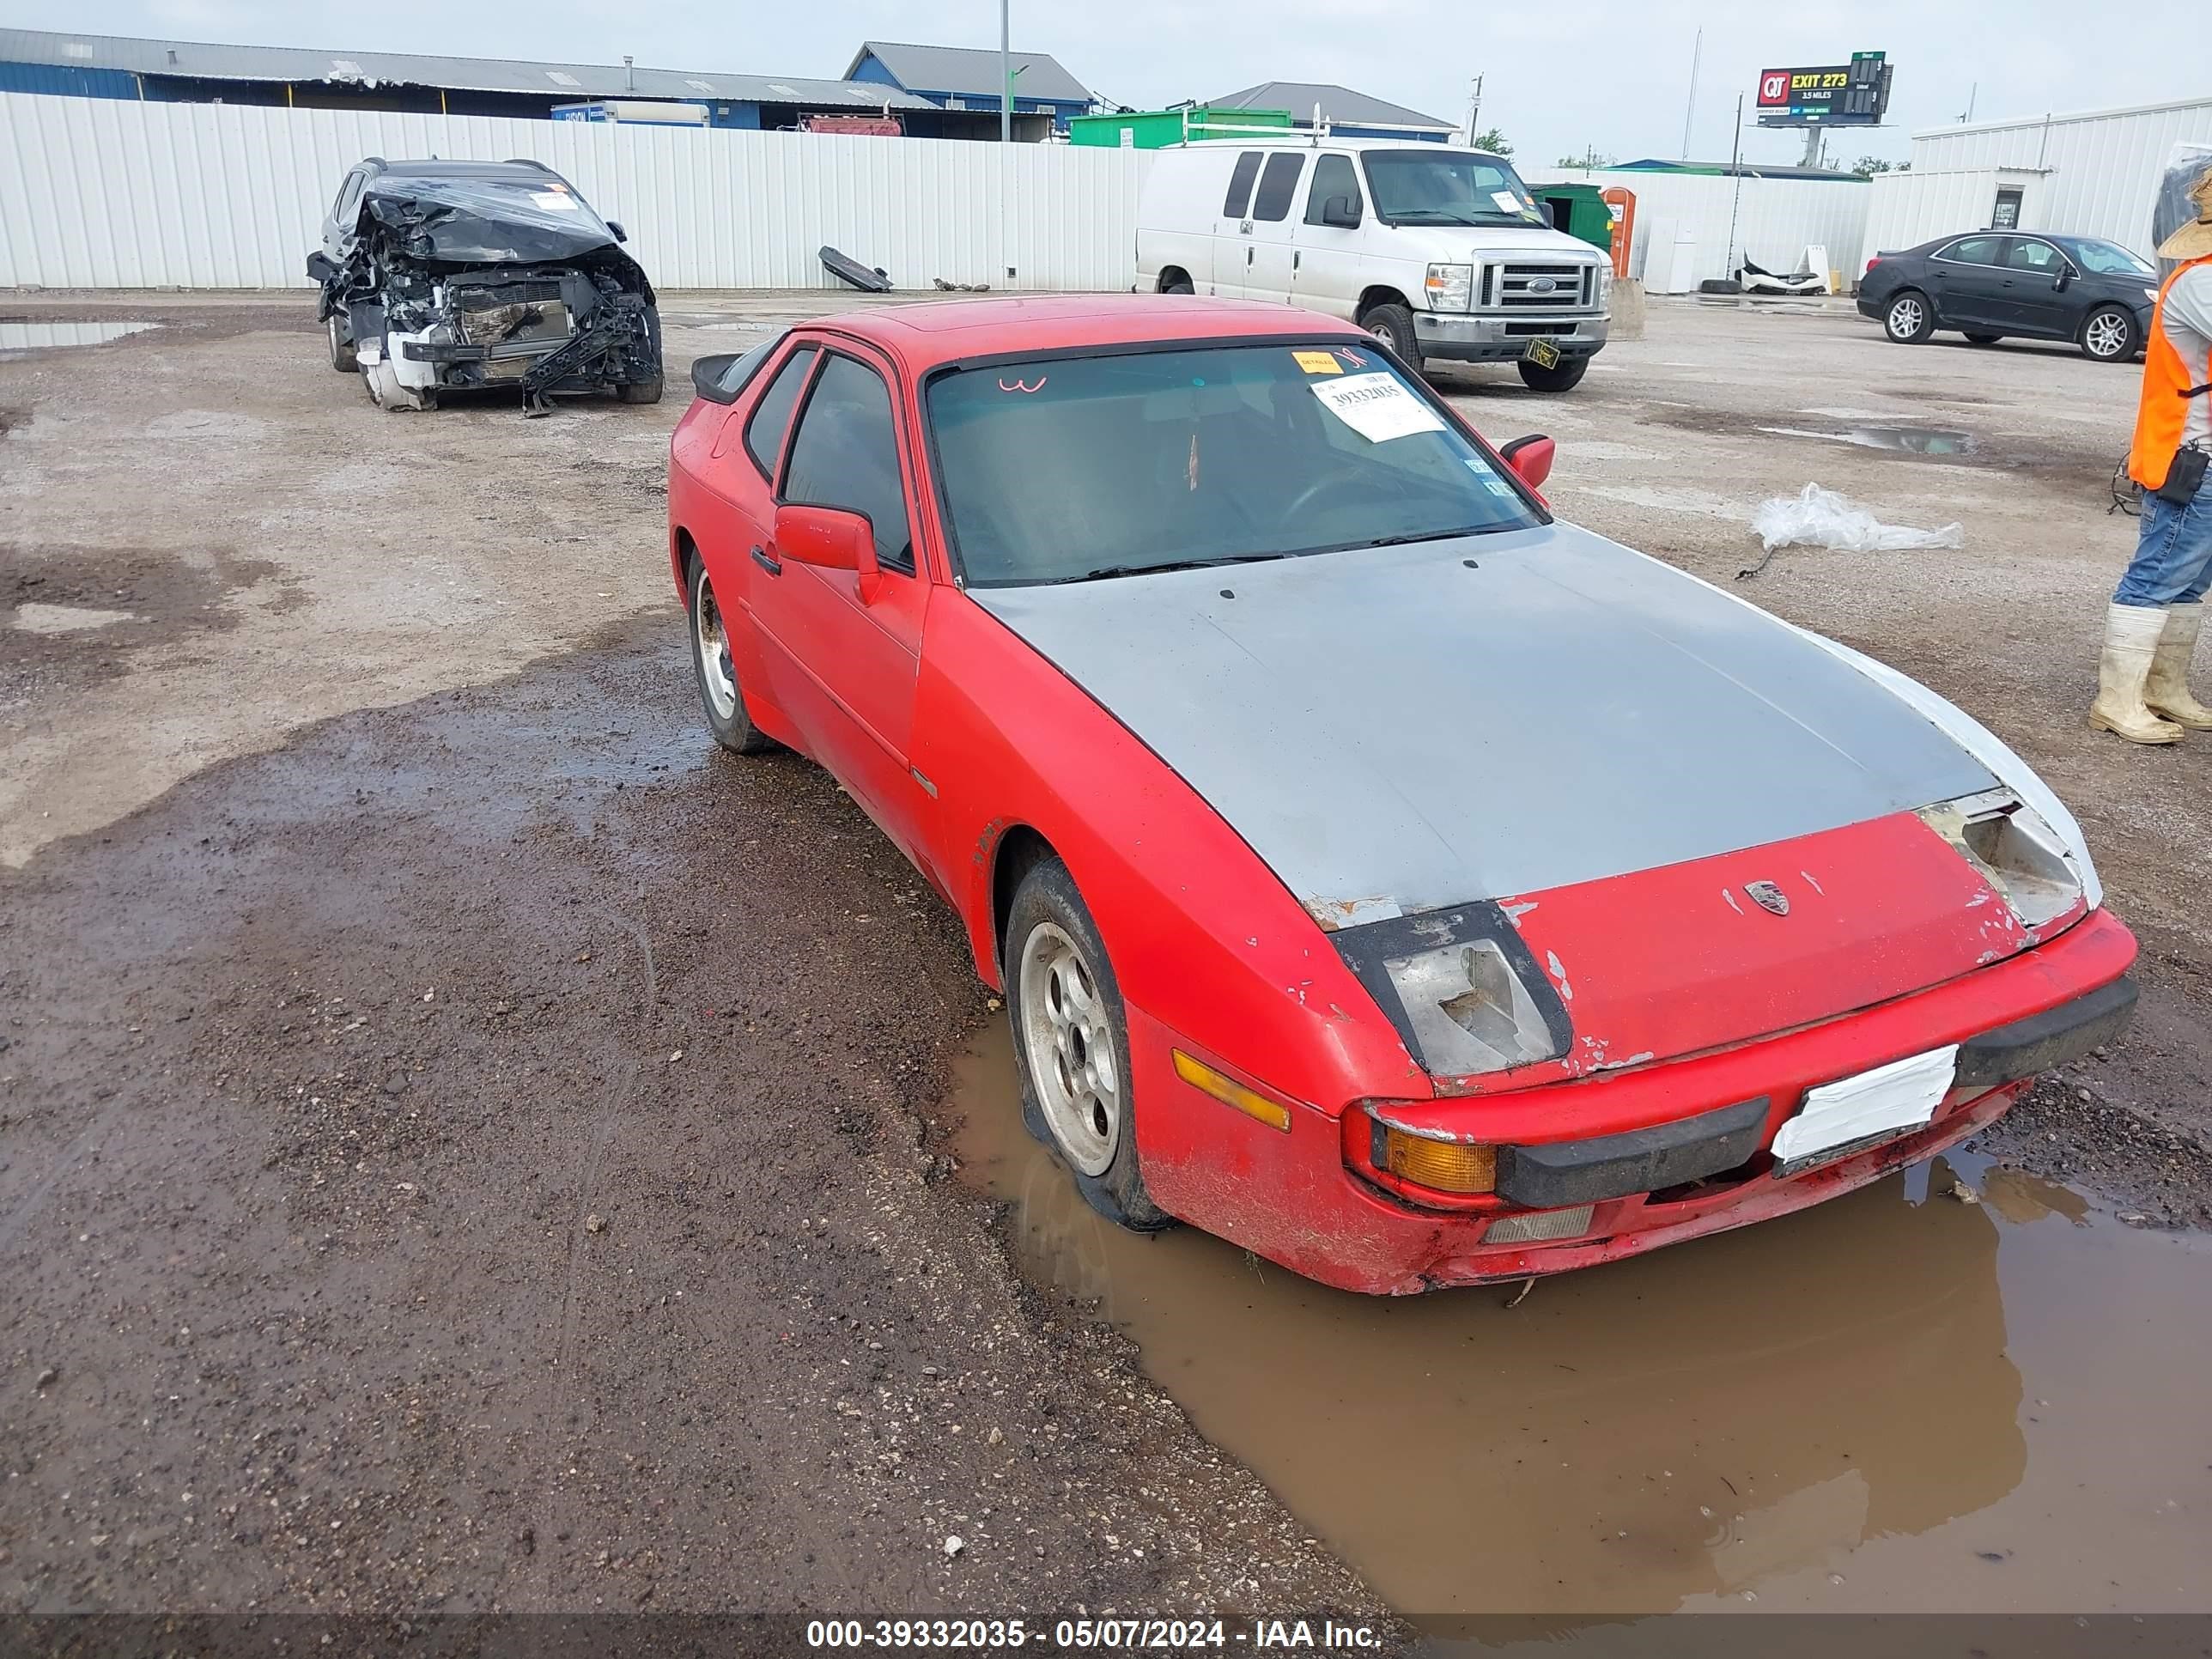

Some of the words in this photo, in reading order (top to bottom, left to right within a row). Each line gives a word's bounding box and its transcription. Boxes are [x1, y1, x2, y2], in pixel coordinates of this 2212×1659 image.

[1764, 76, 1786, 99] QT
[1791, 75, 1820, 88] EXIT
[1822, 74, 1847, 88] 273
[1813, 91, 1832, 100] MILES
[1332, 385, 1401, 407] 39332035
